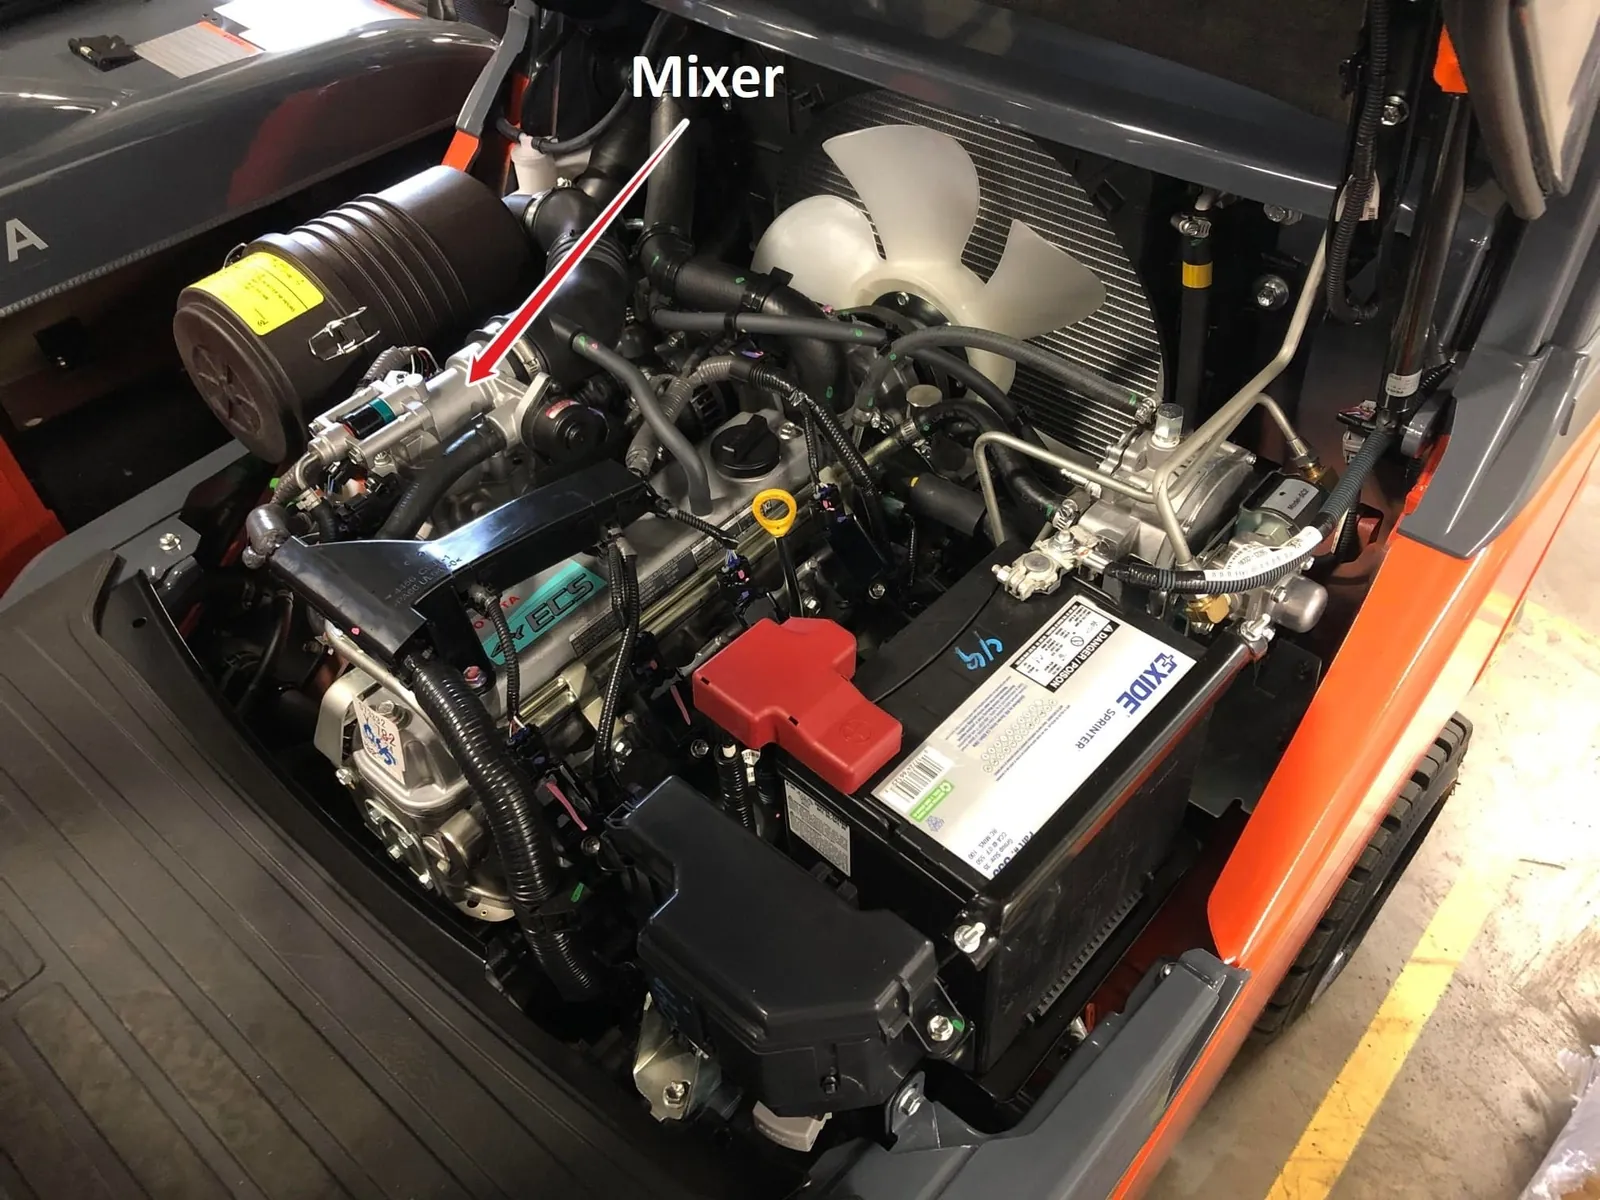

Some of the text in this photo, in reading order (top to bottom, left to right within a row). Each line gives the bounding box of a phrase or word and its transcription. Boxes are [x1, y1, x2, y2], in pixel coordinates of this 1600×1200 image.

[5, 217, 49, 263] A
[524, 573, 595, 633] ECS
[1078, 631, 1109, 661] DANGER
[1049, 659, 1079, 690] POISON
[1116, 652, 1178, 715] EXIDE
[1075, 708, 1116, 750] SPRINTER
[996, 831, 1007, 843] CCA
